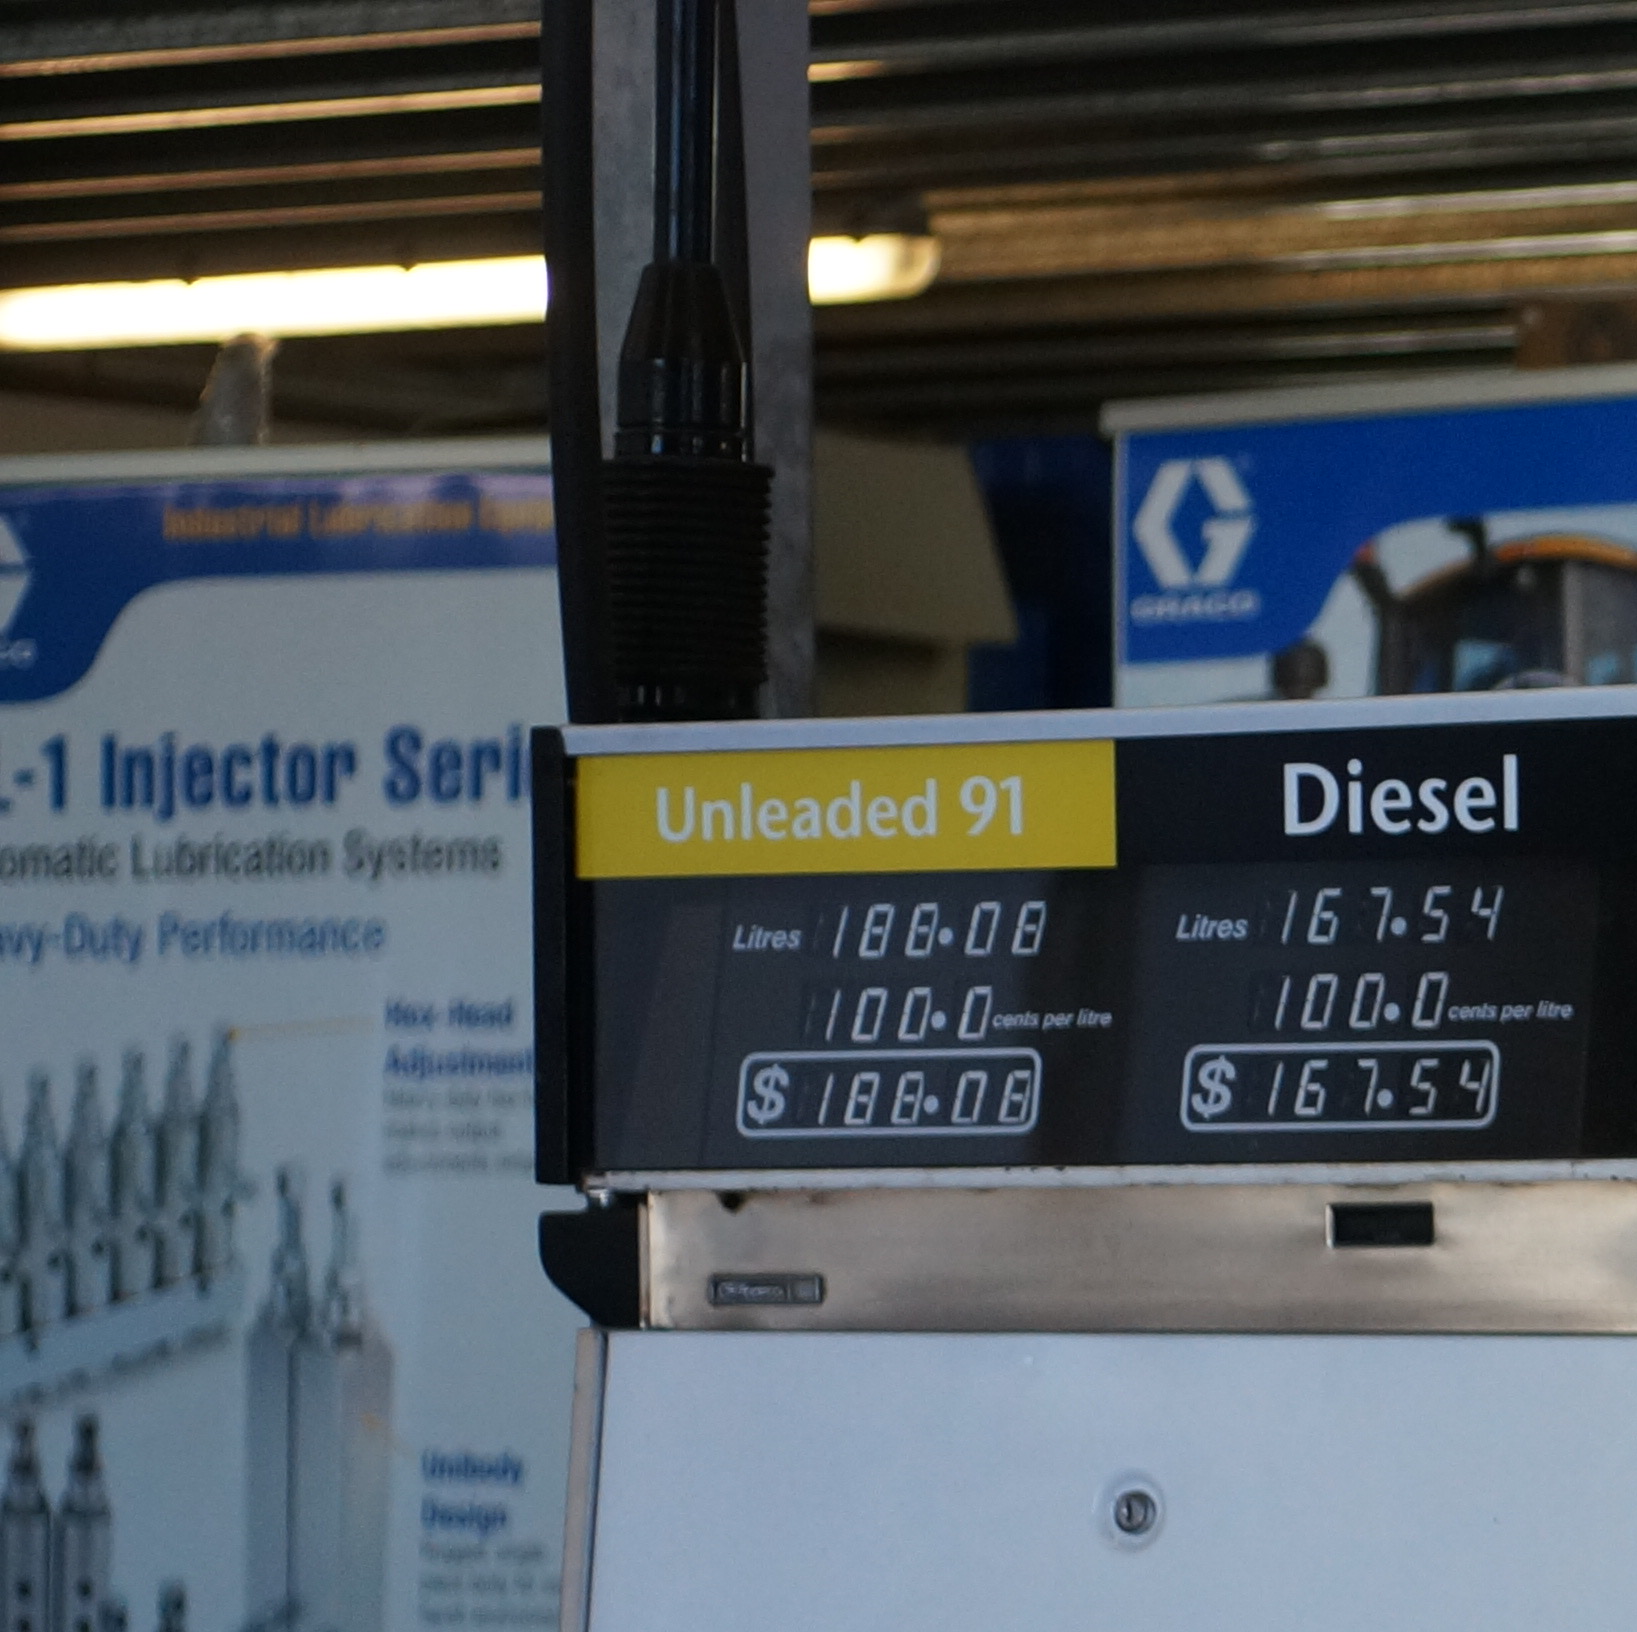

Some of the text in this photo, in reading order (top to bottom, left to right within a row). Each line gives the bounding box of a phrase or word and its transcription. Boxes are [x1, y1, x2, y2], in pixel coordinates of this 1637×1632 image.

[101, 730, 357, 824] Injector
[382, 722, 530, 808] Seri
[1282, 754, 1520, 836] Diesel
[656, 775, 1026, 843] Unleaded 91
[129, 831, 332, 886] Lubrication
[344, 828, 504, 890] Systems
[158, 909, 388, 962] Performance
[733, 901, 1047, 958] Litres 188.08
[1175, 885, 1504, 944] Litres 167.54
[825, 985, 1113, 1043] 100.0 cents per litre
[1274, 970, 1573, 1031] 100.0 cents per litre
